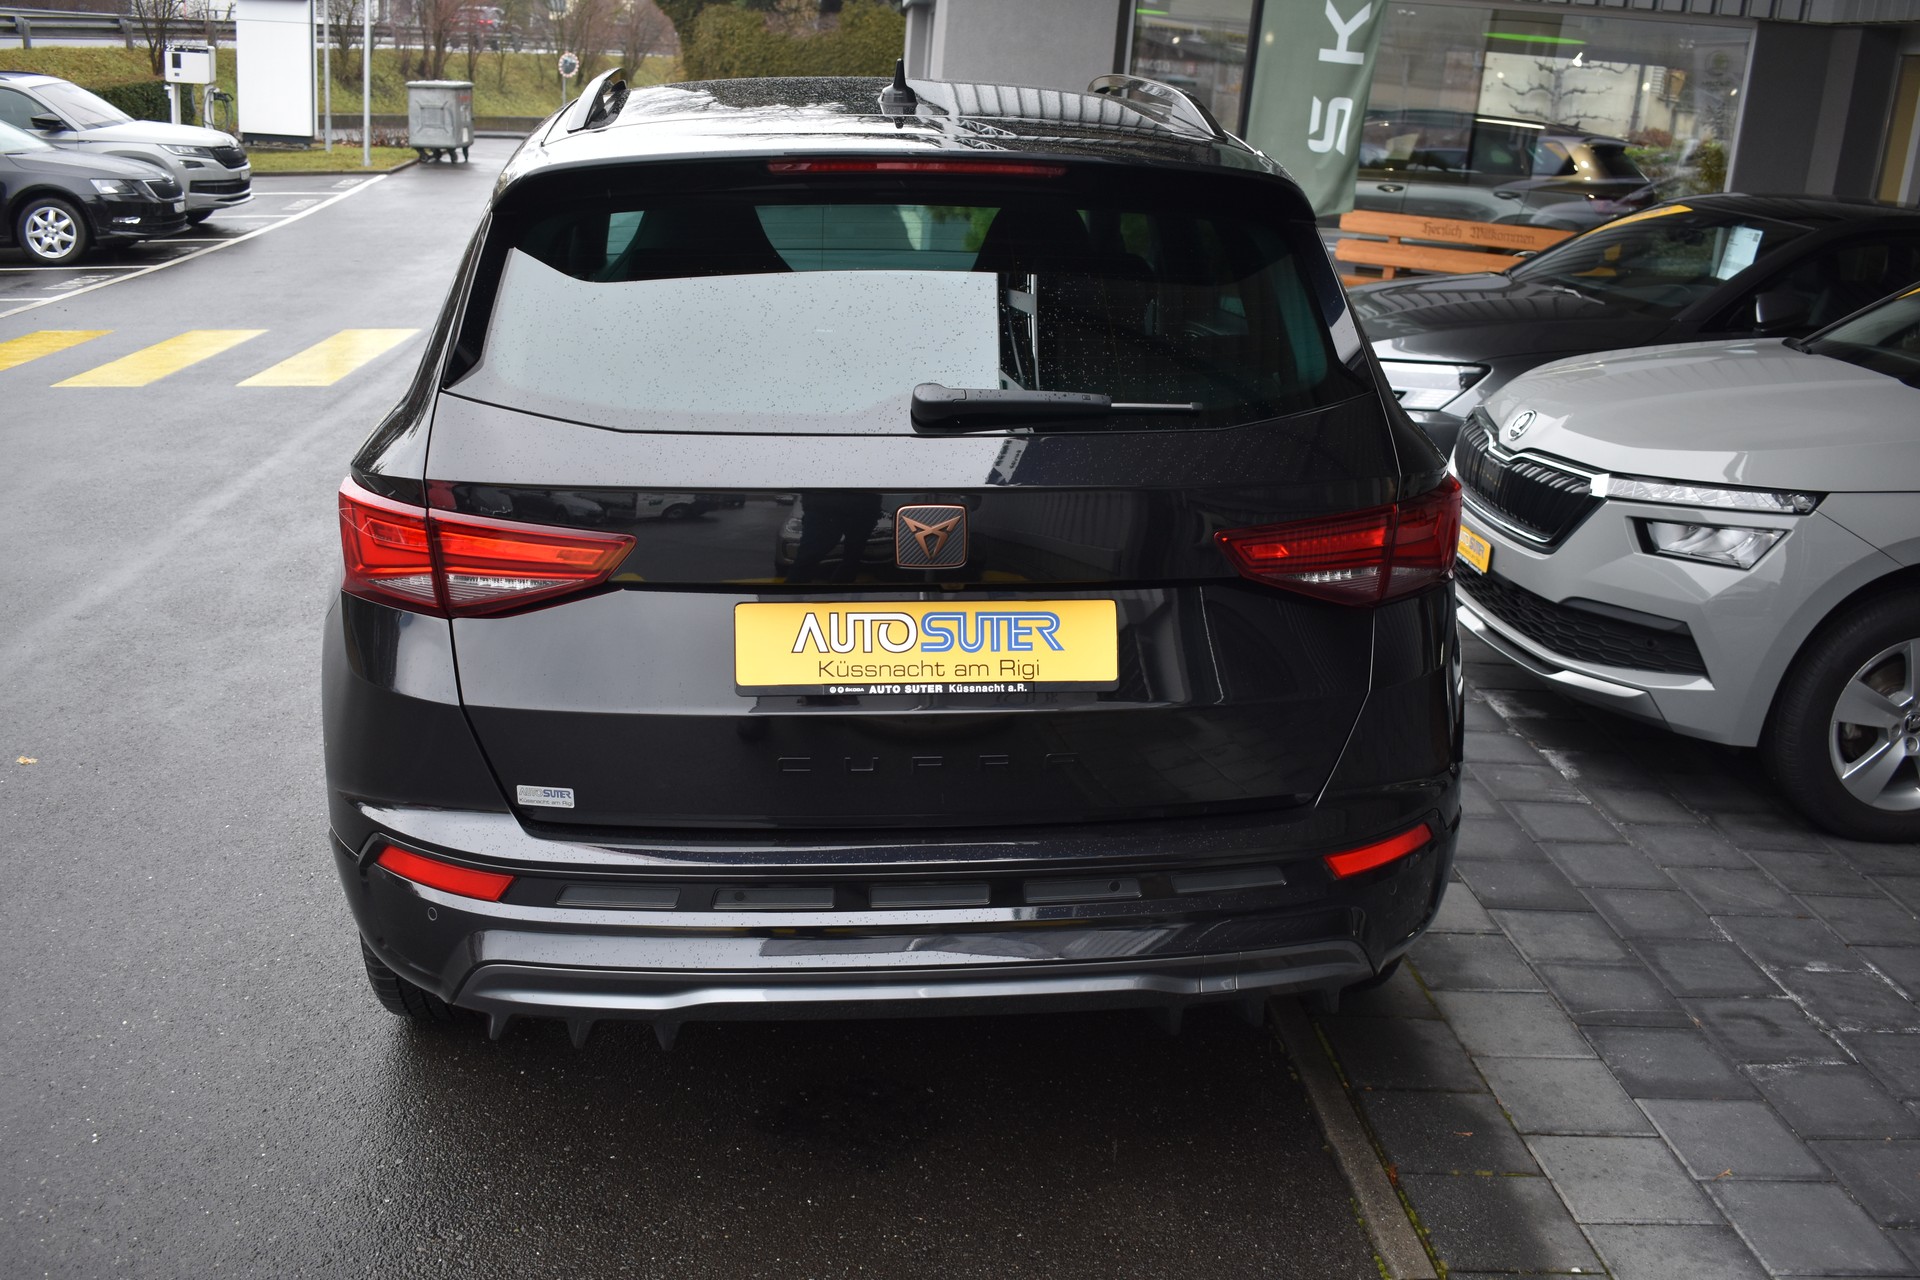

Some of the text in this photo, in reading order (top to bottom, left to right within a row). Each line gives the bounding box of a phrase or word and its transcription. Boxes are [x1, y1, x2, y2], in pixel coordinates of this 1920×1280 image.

[791, 612, 1065, 653] AUTO SUTER
[818, 660, 1040, 680] Küssnacht am Rigi
[869, 685, 901, 694] AUTO
[904, 684, 943, 694] SUTER
[949, 684, 1005, 694] Küssnacht
[1007, 684, 1029, 693] a.R.
[543, 789, 571, 799] SUTER
